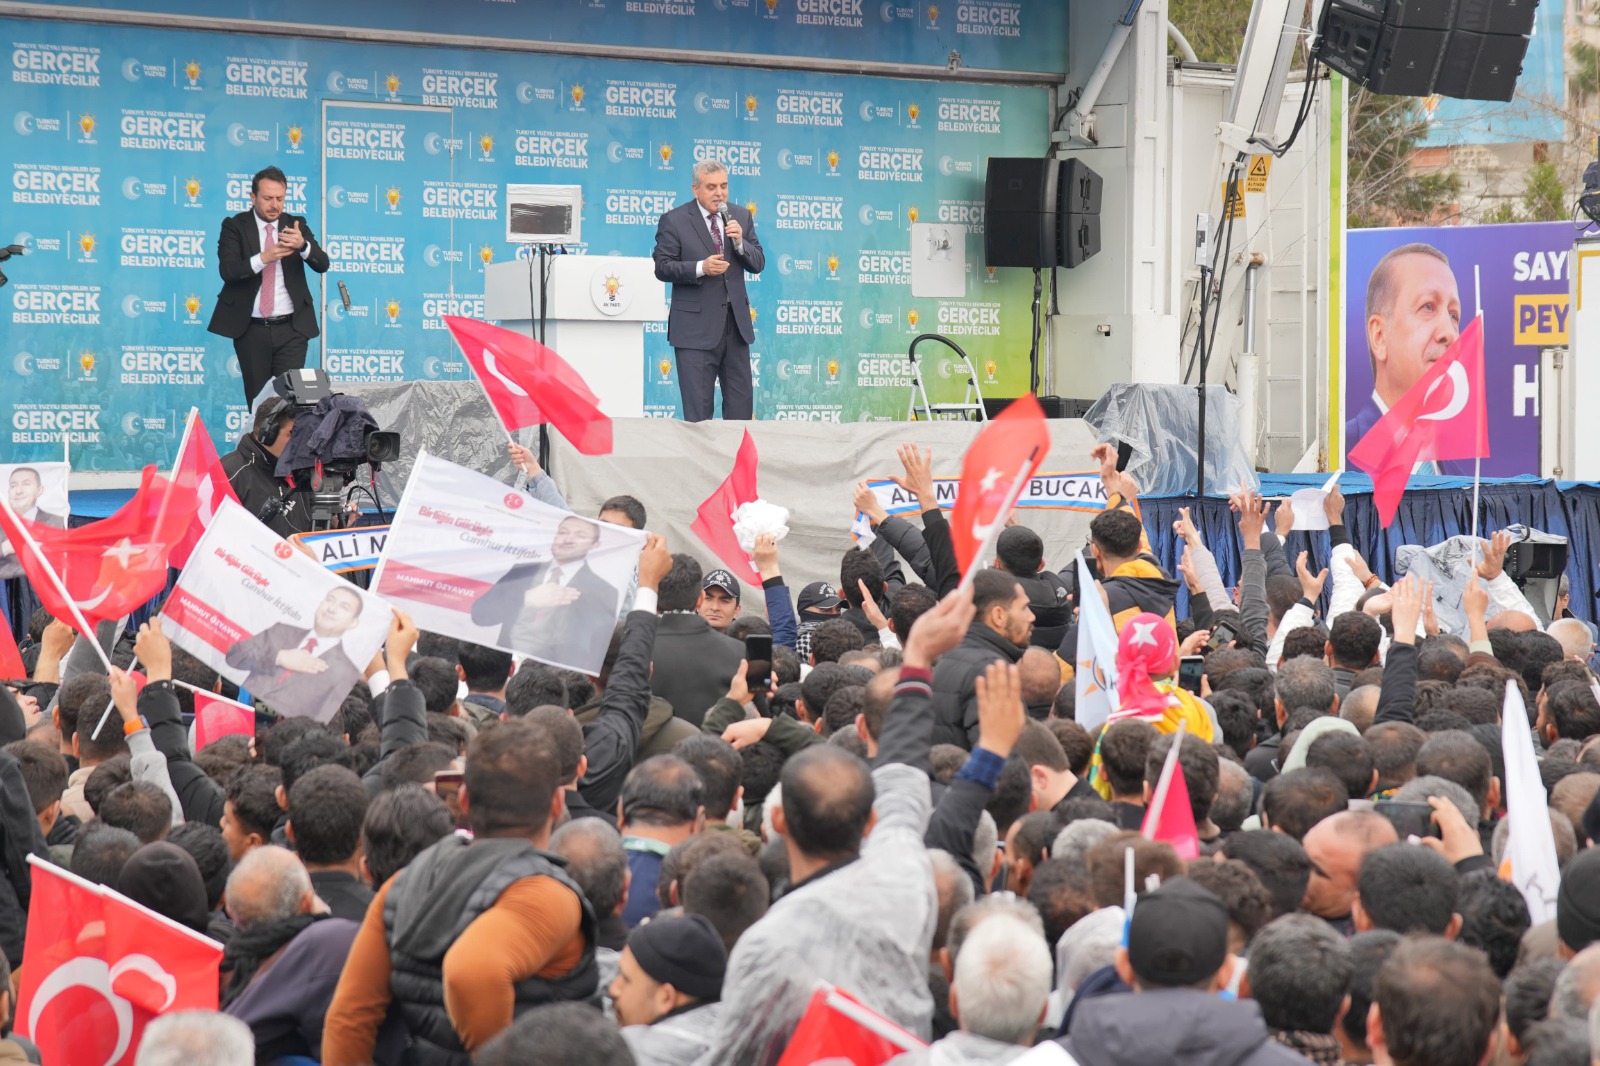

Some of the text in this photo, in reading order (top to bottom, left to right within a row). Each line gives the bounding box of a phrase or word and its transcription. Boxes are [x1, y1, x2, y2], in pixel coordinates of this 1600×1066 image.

[957, 6, 1020, 26] GERÇEK
[13, 50, 100, 74] GERÇEK
[226, 64, 307, 86] GERÇEK
[422, 75, 497, 97] GERÇEK
[606, 86, 676, 107] GERÇEK
[777, 95, 842, 116] GERÇEK
[938, 104, 1000, 123] GERÇEK
[121, 116, 205, 139] GERÇEK
[327, 127, 404, 149] GERÇEK
[516, 136, 588, 157] GERÇEK
[693, 145, 760, 165] GERÇEK
[859, 152, 922, 172] GERÇEK
[13, 170, 100, 194] GERÇEK
[423, 188, 496, 209] GERÇEK
[606, 195, 676, 215] GERÇEK
[777, 200, 842, 221] GERÇEK
[121, 234, 205, 257] GERÇEK
[327, 241, 404, 263] GERÇEK
[1513, 250, 1569, 281] SAY
[13, 291, 100, 313] GERÇEK
[776, 306, 842, 325] GERÇEK
[938, 306, 1000, 326] GERÇEK
[121, 352, 204, 374] GERÇEK
[327, 355, 404, 375] GERÇEK
[13, 411, 100, 432] GERÇEK
[892, 488, 918, 504] AL
[1030, 480, 1108, 500] BUCAK
[323, 534, 359, 562] ALİ
[460, 532, 504, 551] Cumhur
[241, 577, 274, 602] Cumhur
[396, 573, 434, 587] MAHMUT
[435, 581, 475, 597] ÖZYAVUZ
[180, 596, 211, 619] MAHMUT
